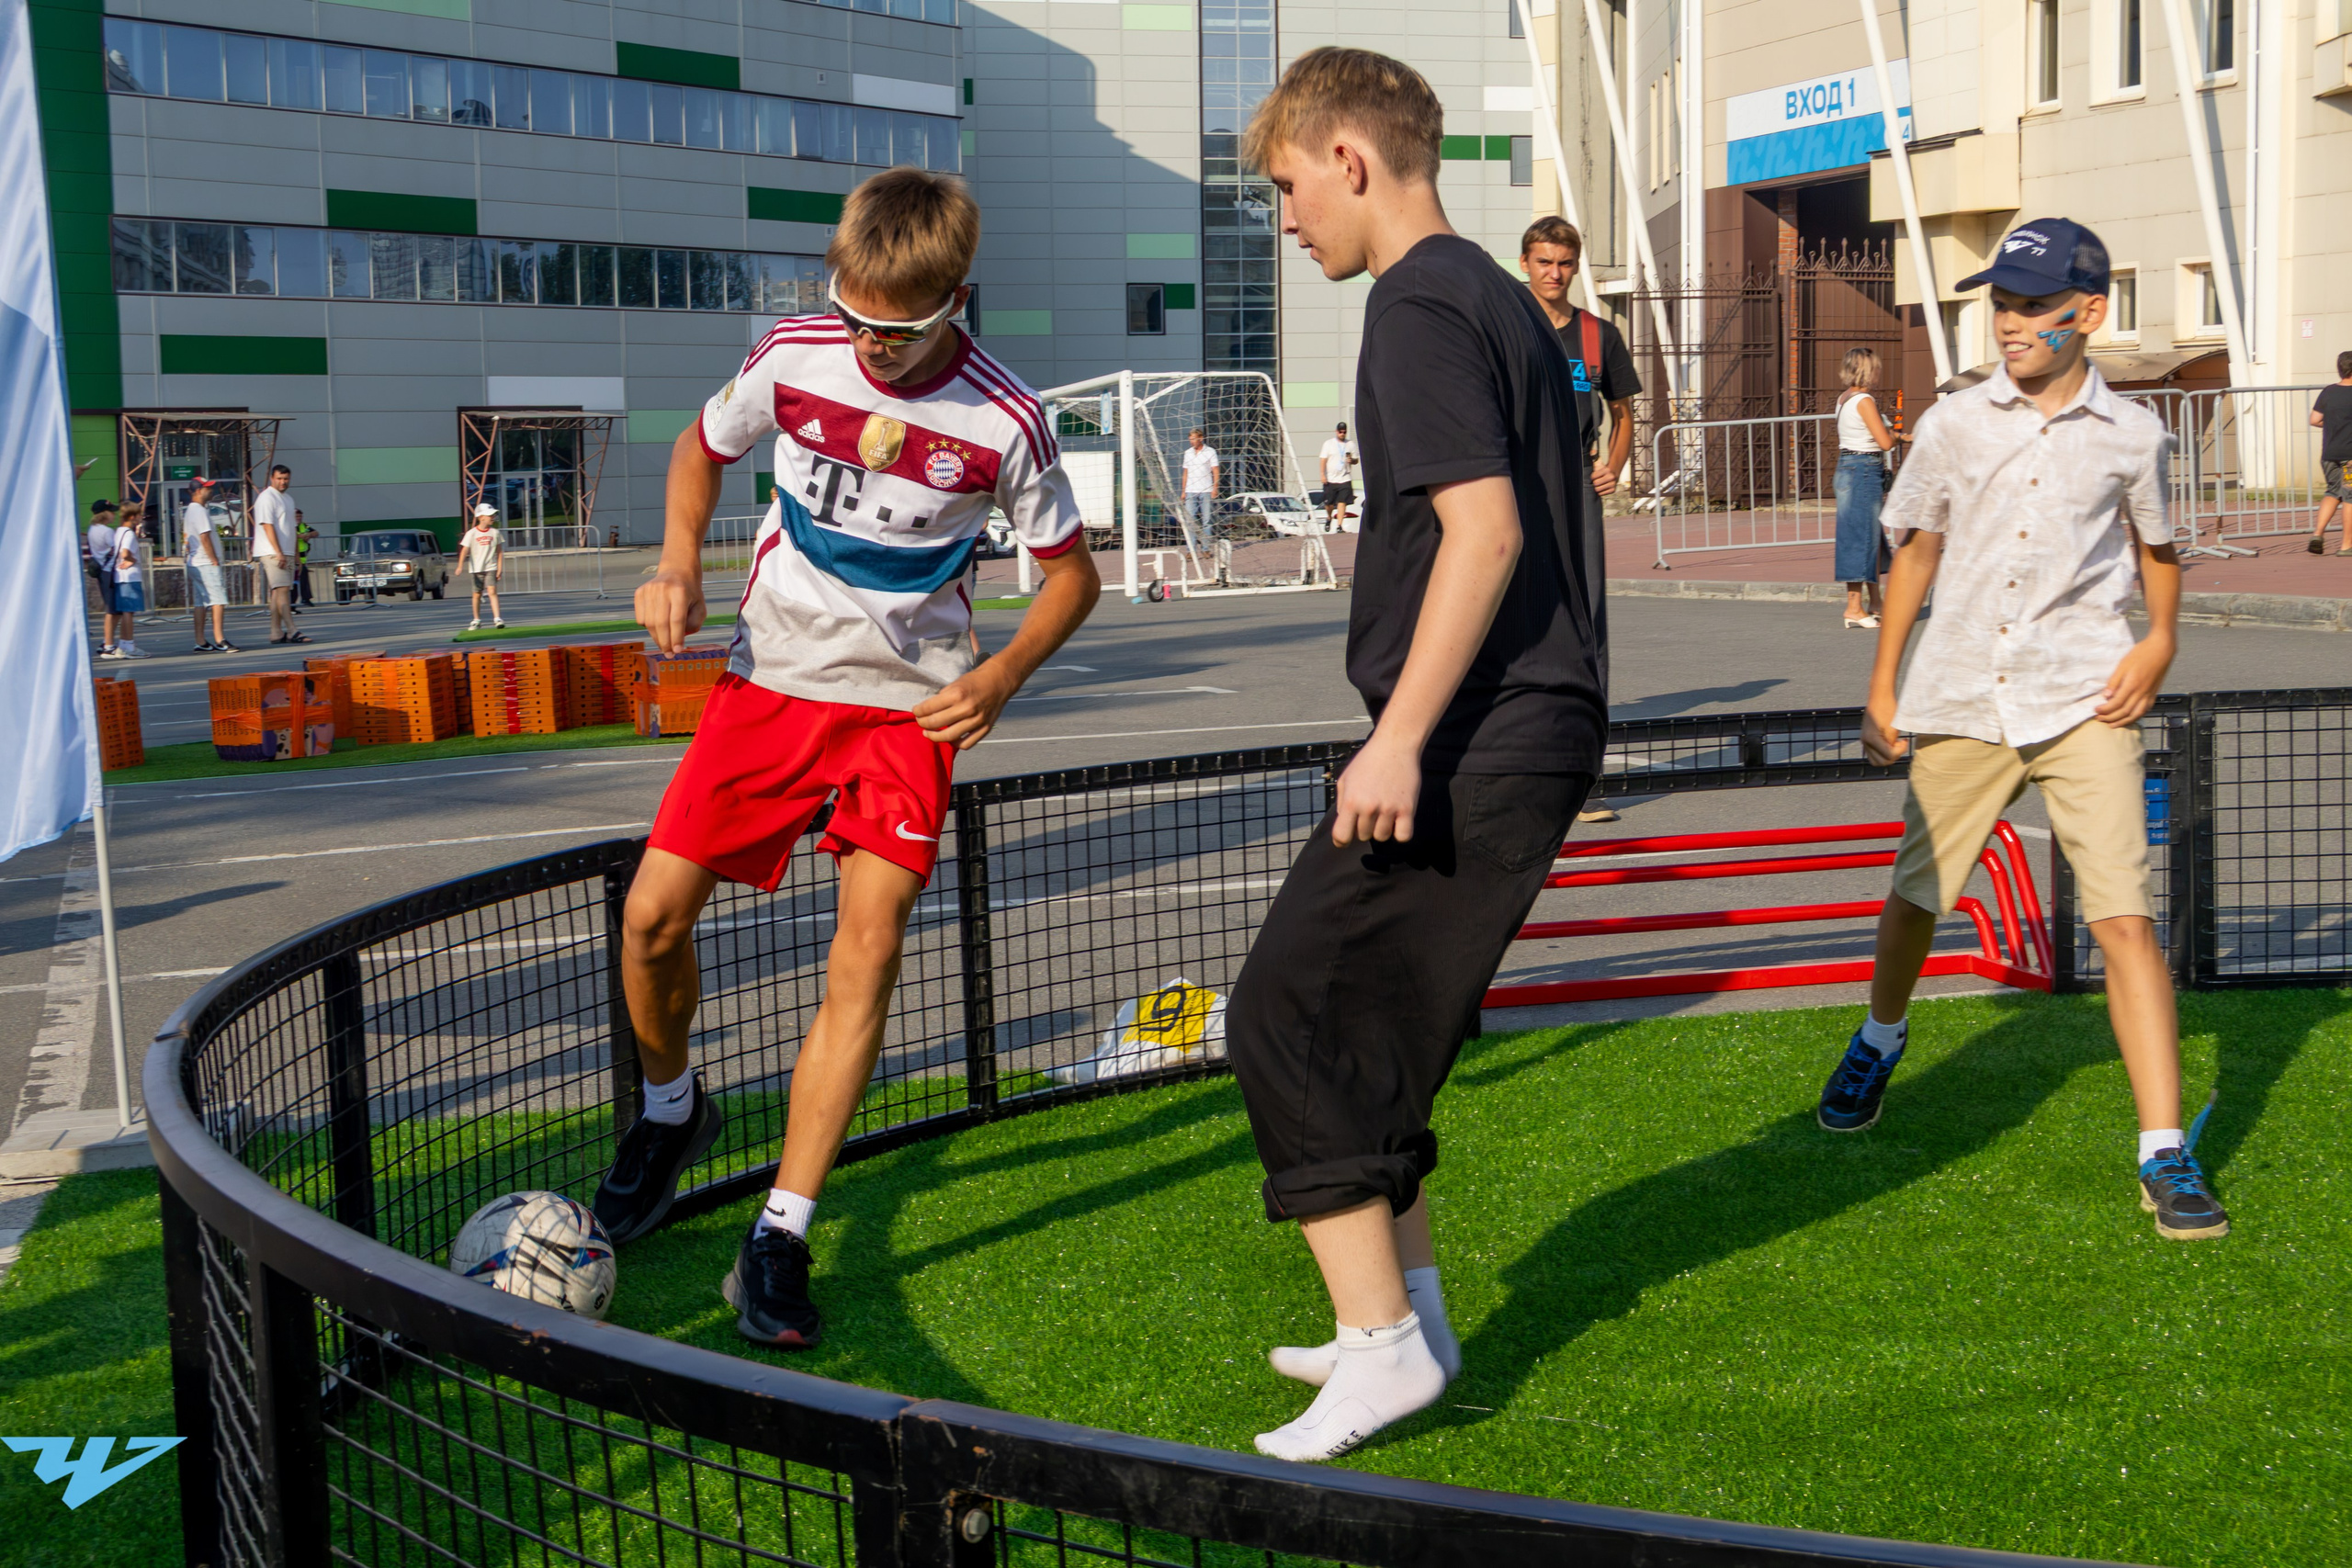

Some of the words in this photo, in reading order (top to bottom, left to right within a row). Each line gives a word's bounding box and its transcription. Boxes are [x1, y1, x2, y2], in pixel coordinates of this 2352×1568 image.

[1785, 80, 1843, 120] ВХОД
[1848, 77, 1856, 107] 1
[797, 428, 826, 444] adidas
[868, 449, 888, 460] FIFA
[939, 452, 963, 473] BAYERN
[1326, 1429, 1364, 1456] NIKE
